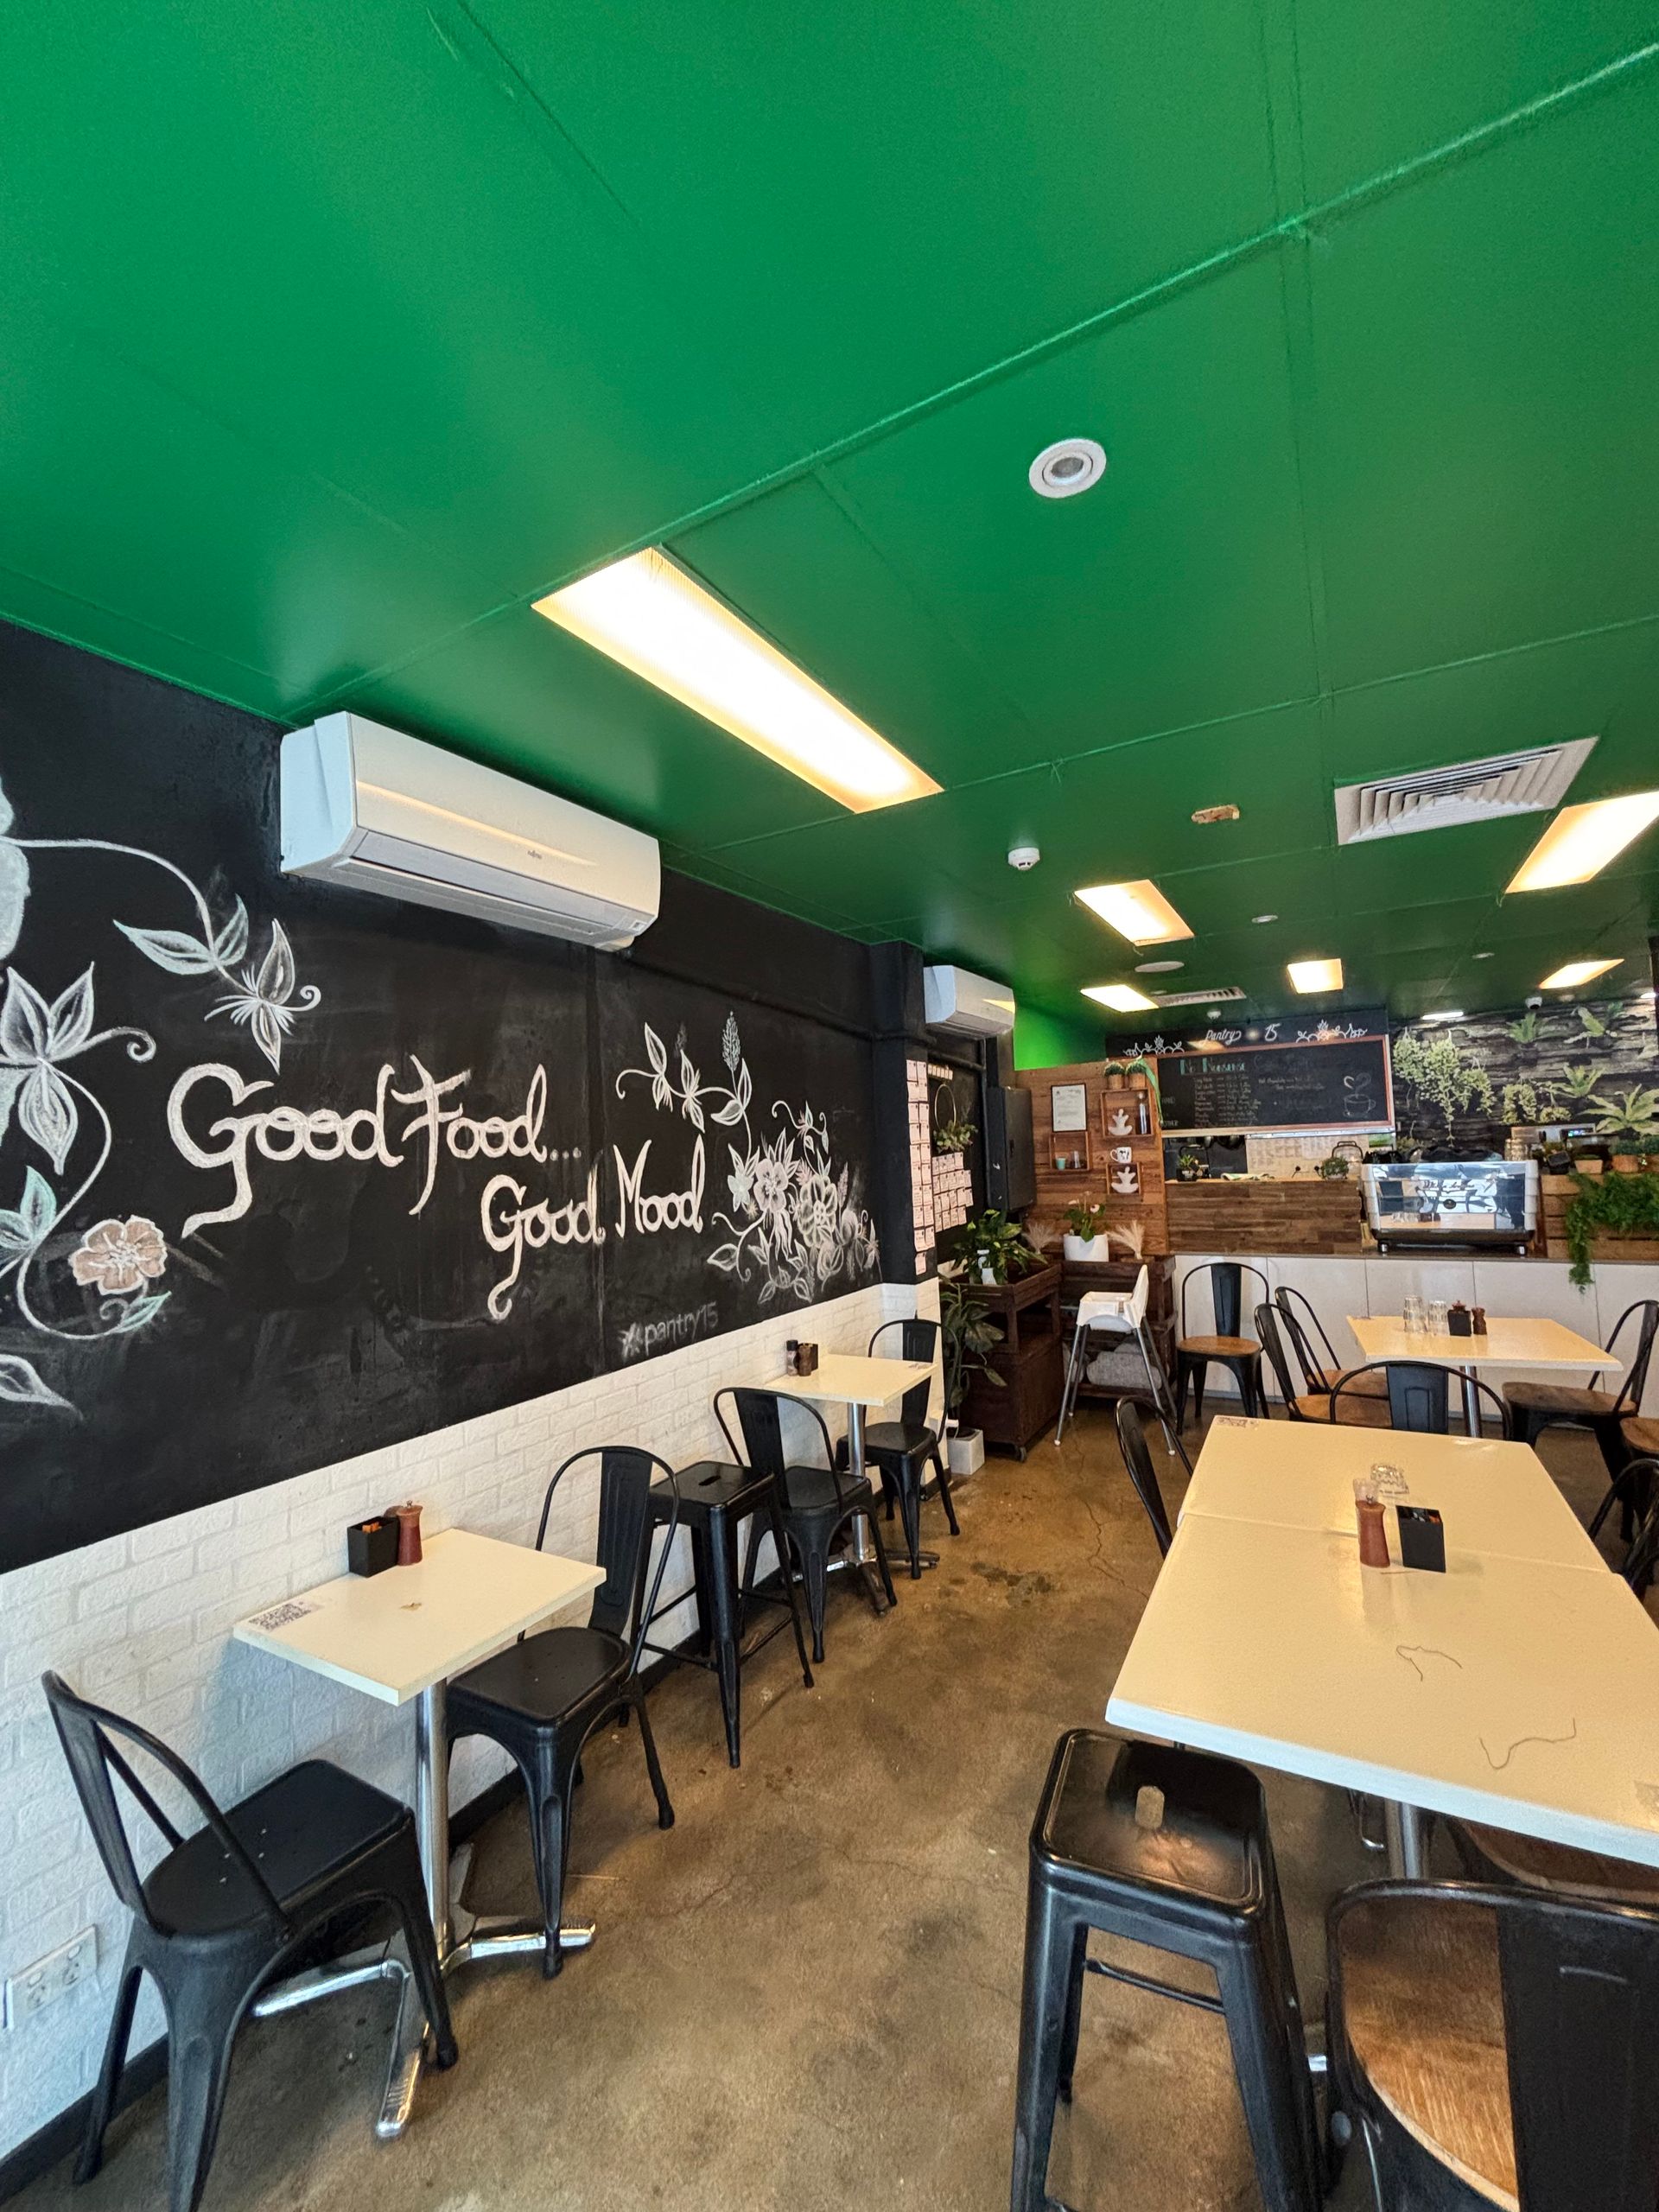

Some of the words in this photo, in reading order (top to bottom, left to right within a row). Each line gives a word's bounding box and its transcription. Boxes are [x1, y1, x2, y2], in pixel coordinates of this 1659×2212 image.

[1264, 1023, 1281, 1042] 15
[167, 1062, 404, 1239] Good
[480, 1163, 606, 1321] Good
[613, 1133, 705, 1239] Mood
